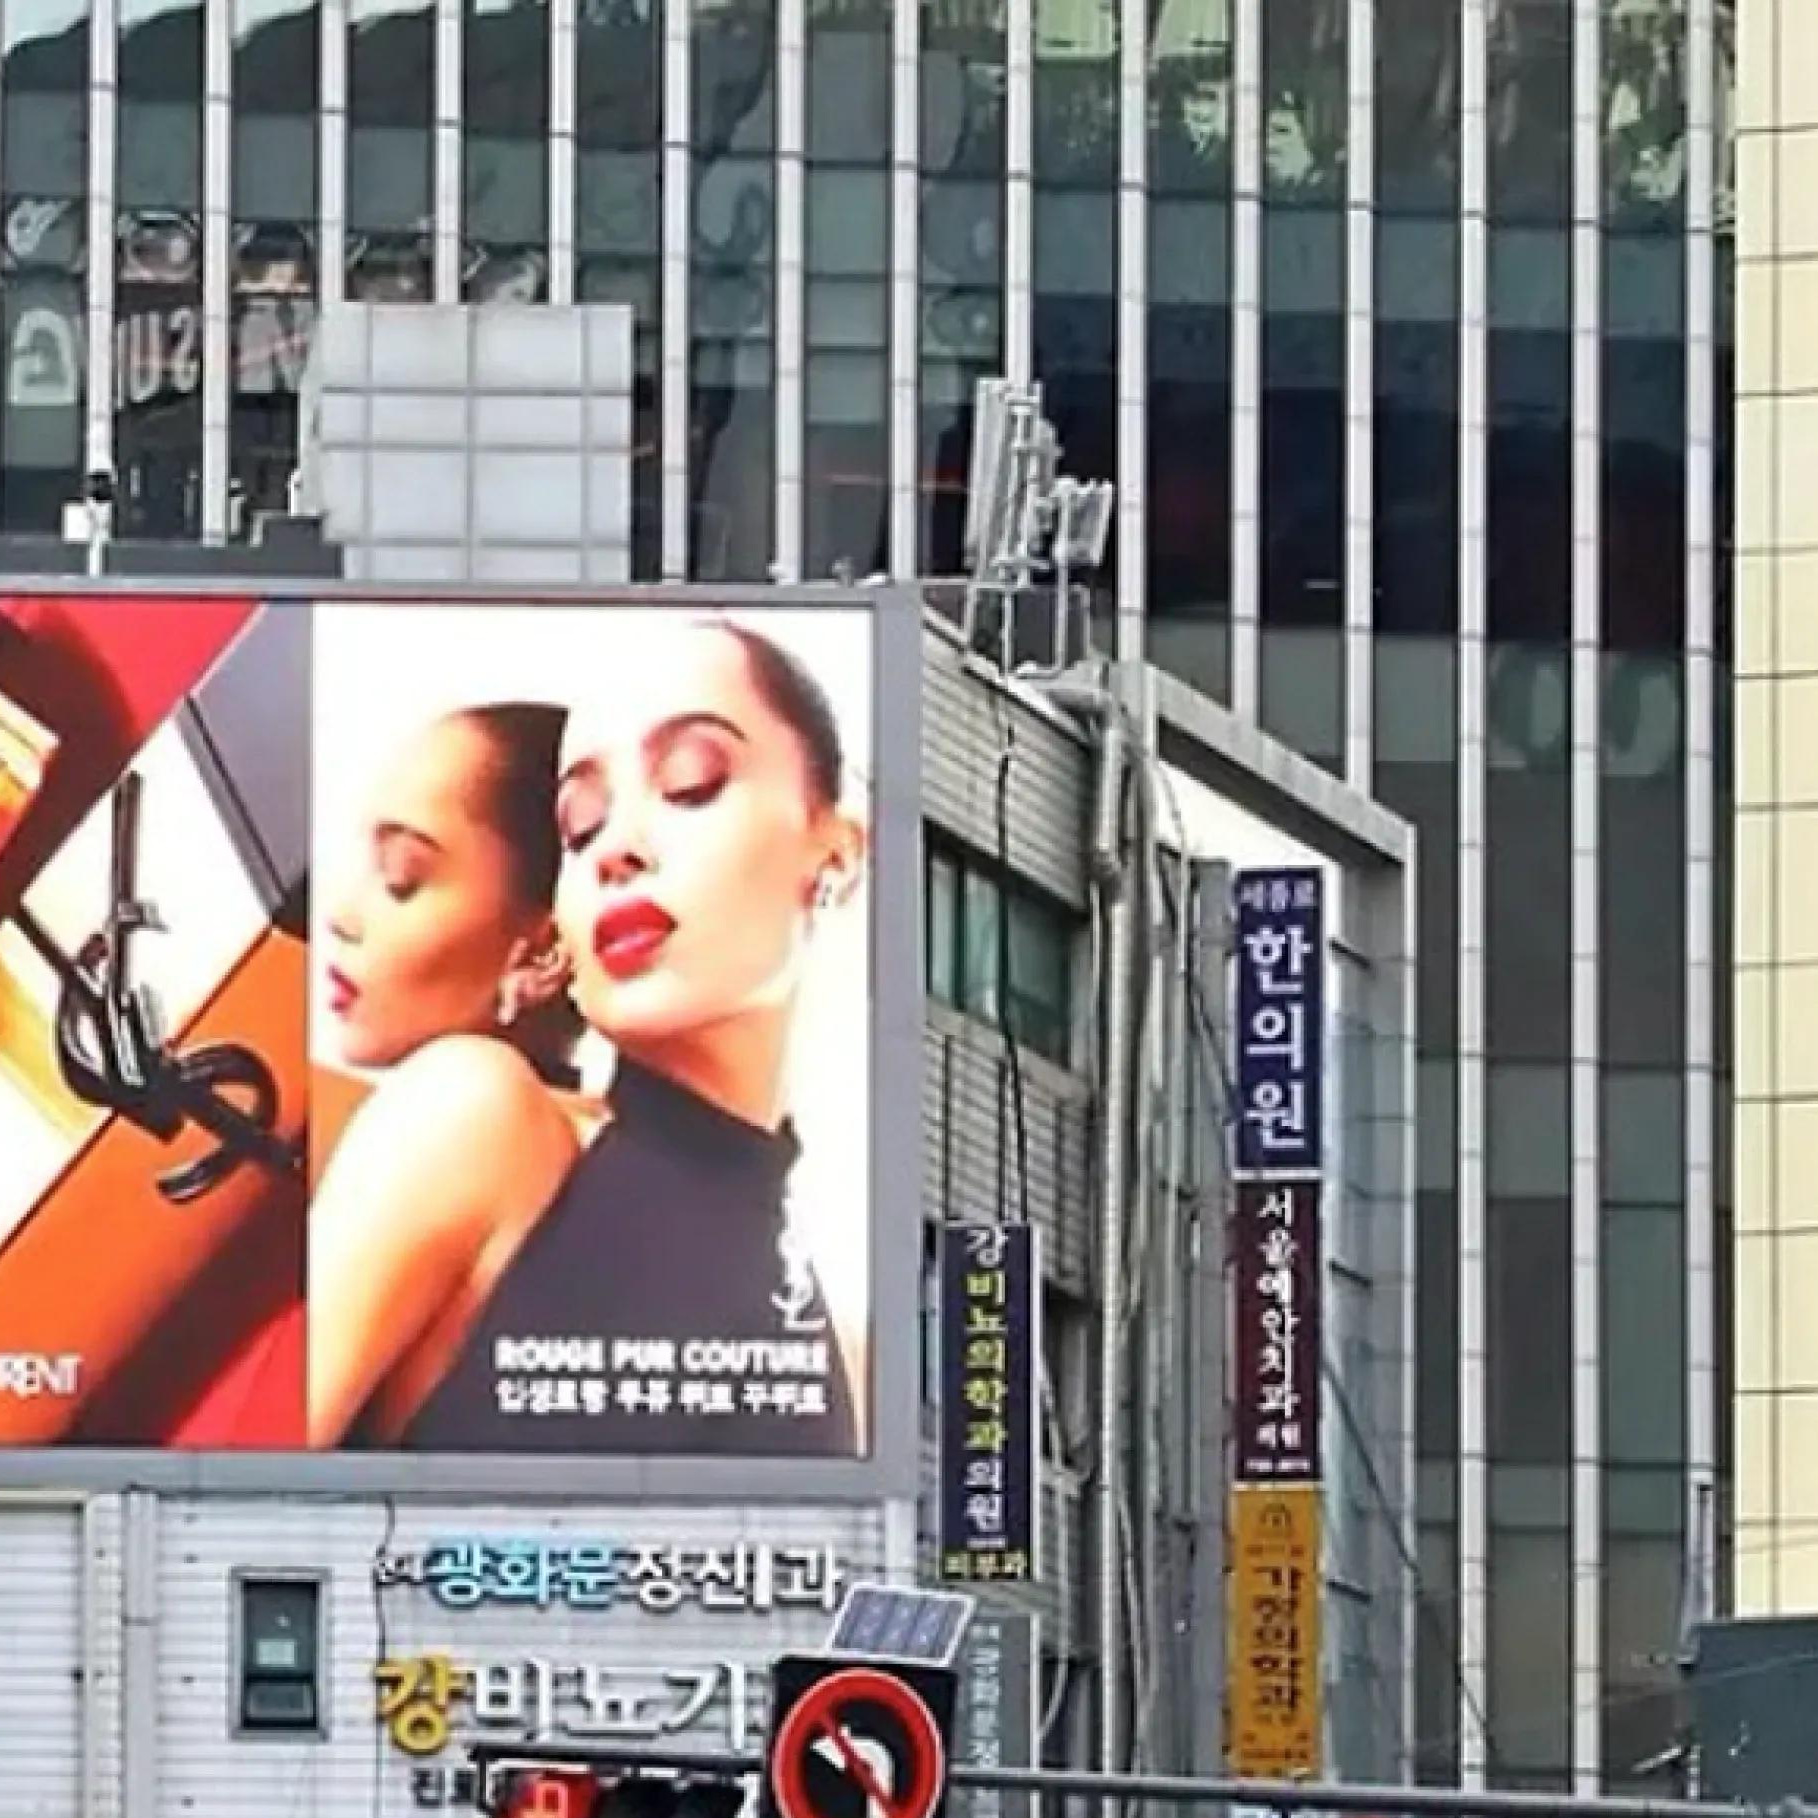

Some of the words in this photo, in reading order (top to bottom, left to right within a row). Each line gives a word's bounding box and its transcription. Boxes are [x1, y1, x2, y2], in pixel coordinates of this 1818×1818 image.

[1244, 925, 1312, 1150] 한의원
[495, 1336, 604, 1373] ROUGE
[613, 1338, 676, 1373] PUR
[683, 1339, 829, 1376] COUTURE
